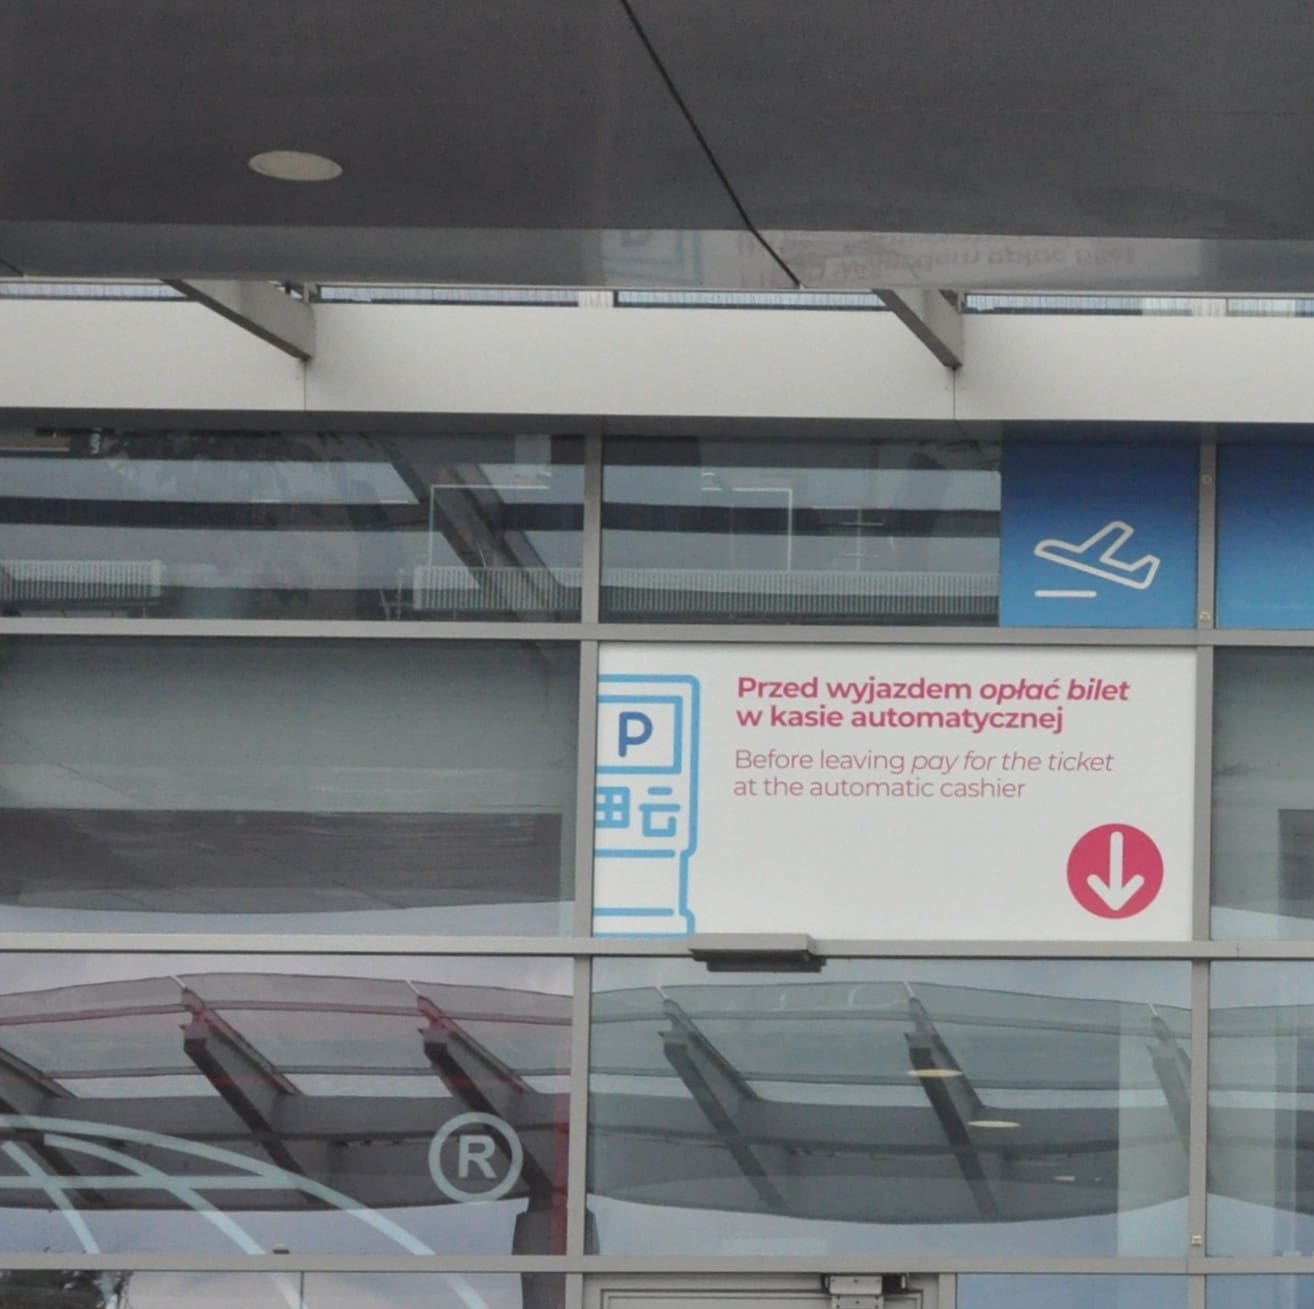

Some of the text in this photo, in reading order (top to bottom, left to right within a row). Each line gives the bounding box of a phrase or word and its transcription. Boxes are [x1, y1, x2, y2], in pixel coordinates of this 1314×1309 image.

[736, 676, 1131, 706] Przed wyjazdem opłać bilet
[735, 704, 1065, 735] w kasie automatycznej
[735, 749, 1115, 776] Before leaving pay for the ticket
[733, 777, 1027, 799] at the automatic cashier
